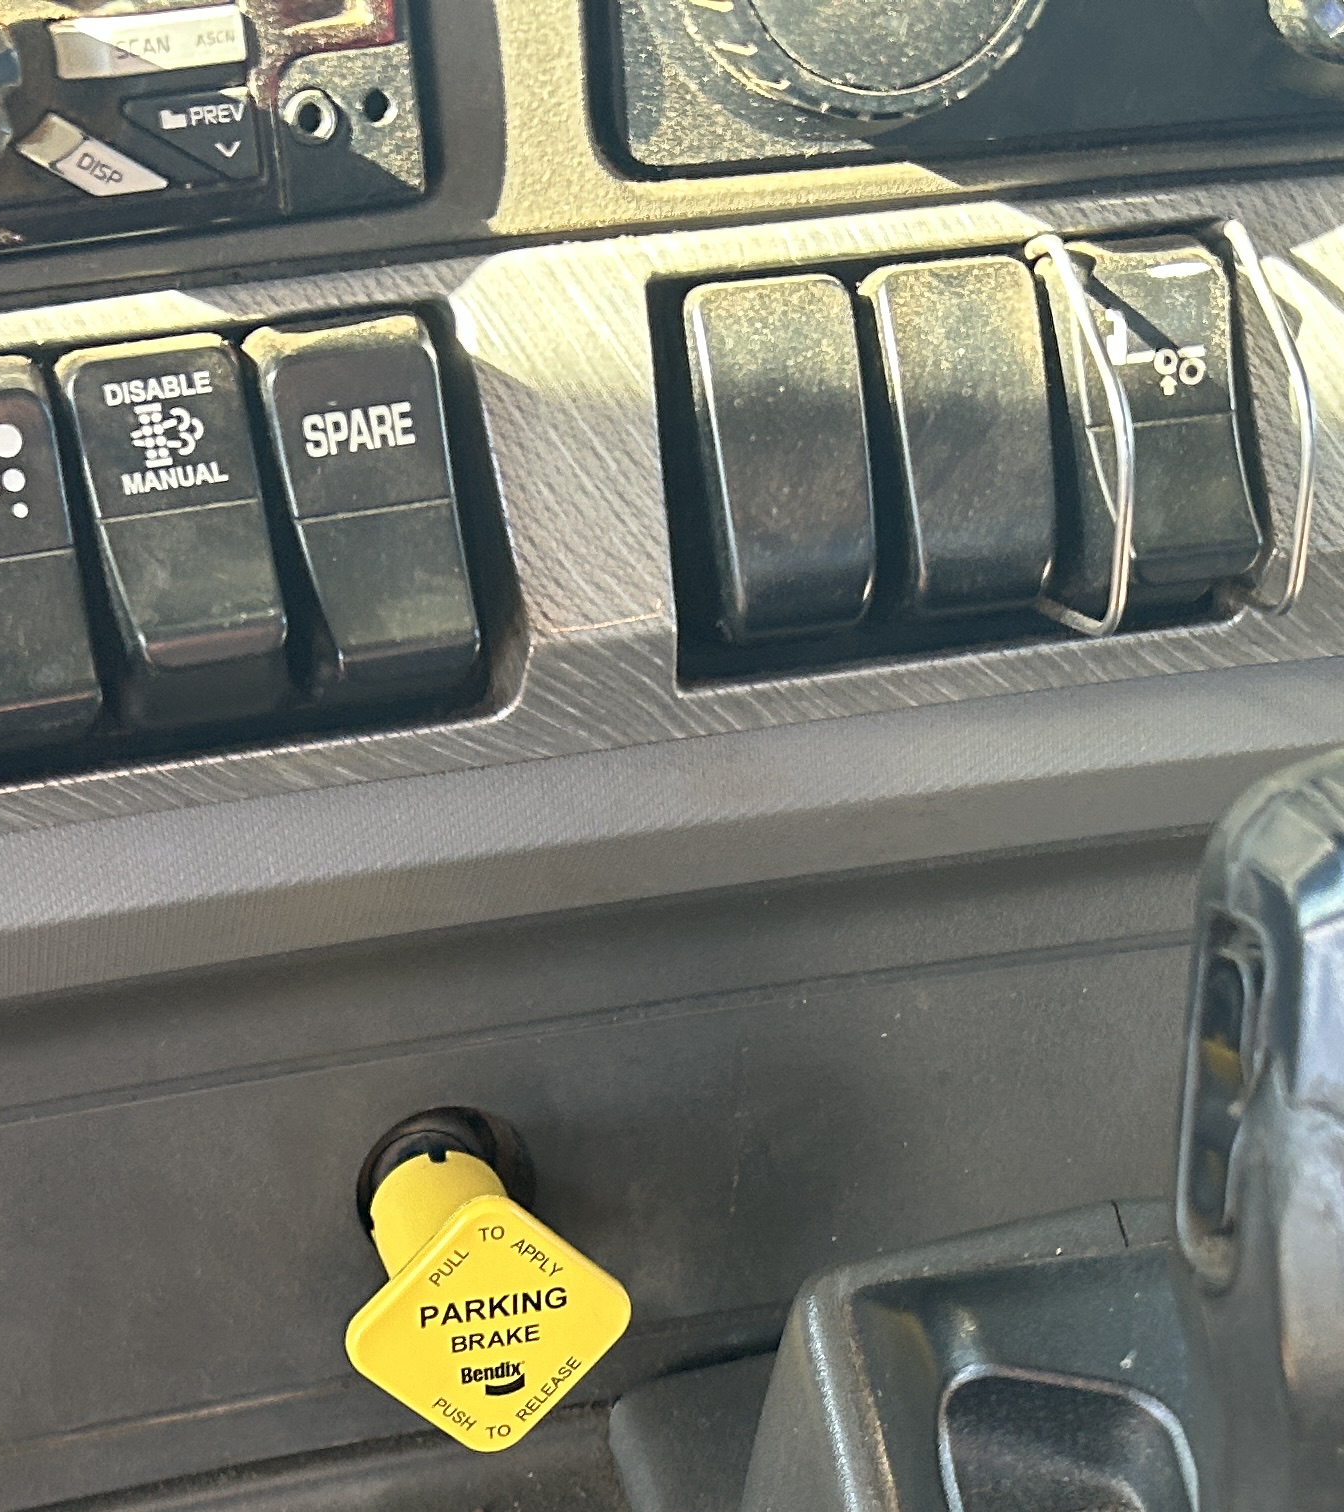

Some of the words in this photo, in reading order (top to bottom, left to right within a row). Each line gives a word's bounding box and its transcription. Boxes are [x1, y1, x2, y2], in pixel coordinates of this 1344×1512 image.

[115, 34, 171, 60] SCAN
[192, 105, 244, 126] PREV
[76, 151, 123, 185] DISP
[104, 371, 212, 405] DISABLE
[303, 402, 415, 457] SPARE
[122, 462, 228, 495] MANUAL
[429, 1249, 469, 1286] PULL
[478, 1226, 505, 1242] TO
[511, 1239, 563, 1277] APPLY
[420, 1287, 567, 1328] PARKING
[451, 1325, 540, 1353] BRAKE
[461, 1361, 521, 1385] Bendix
[432, 1397, 477, 1431] PUSH
[485, 1424, 511, 1438] TO
[515, 1357, 581, 1421] RELEASE
